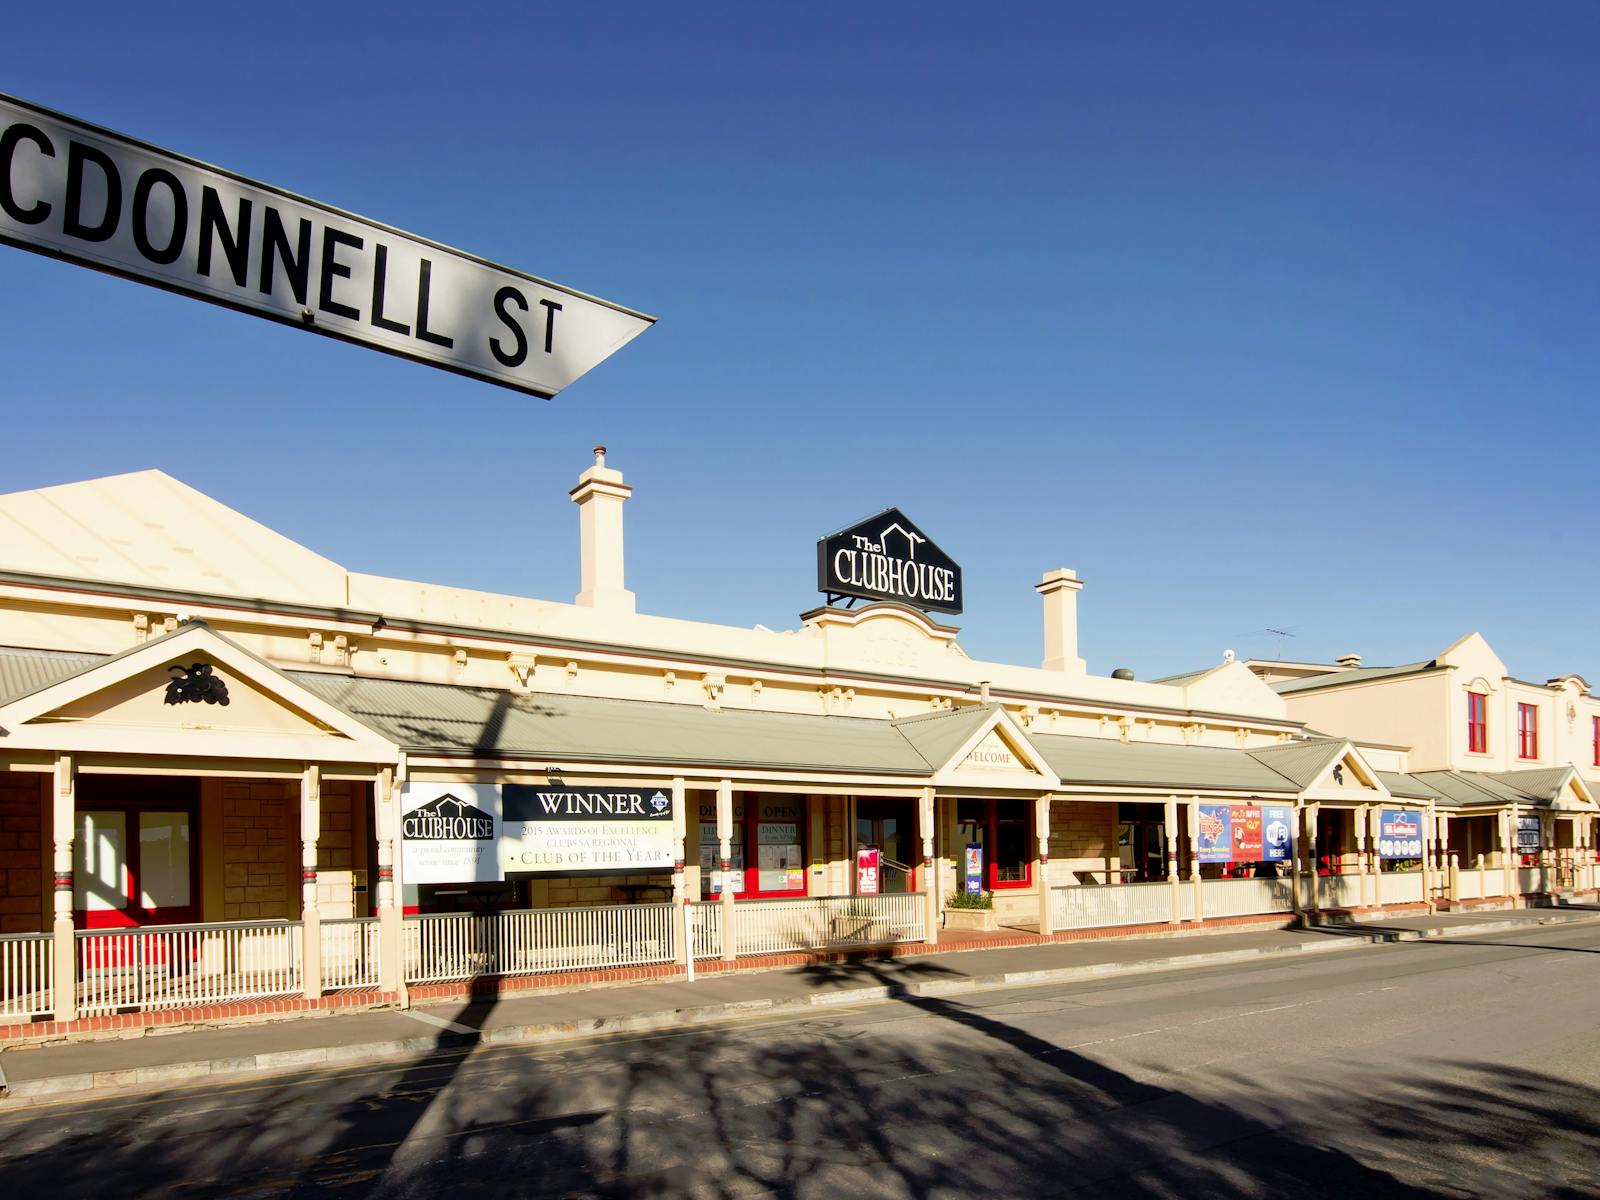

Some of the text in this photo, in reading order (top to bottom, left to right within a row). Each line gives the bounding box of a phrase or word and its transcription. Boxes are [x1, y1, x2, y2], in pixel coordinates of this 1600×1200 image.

[852, 535, 882, 552] The
[834, 548, 955, 601] CLUBHOUSE
[536, 793, 645, 814] WINNER
[415, 808, 437, 818] The
[764, 806, 797, 817] OPEN
[403, 817, 493, 839] CLUBHOUSE
[521, 826, 543, 836] 2015
[545, 826, 586, 836] AWARDS
[602, 825, 658, 835] EXCELLENCE
[762, 826, 796, 834] DINNER
[1200, 823, 1224, 834] BINGO
[592, 838, 638, 847] REGIONAL
[521, 848, 663, 865] CLUB OF THE YEAR
